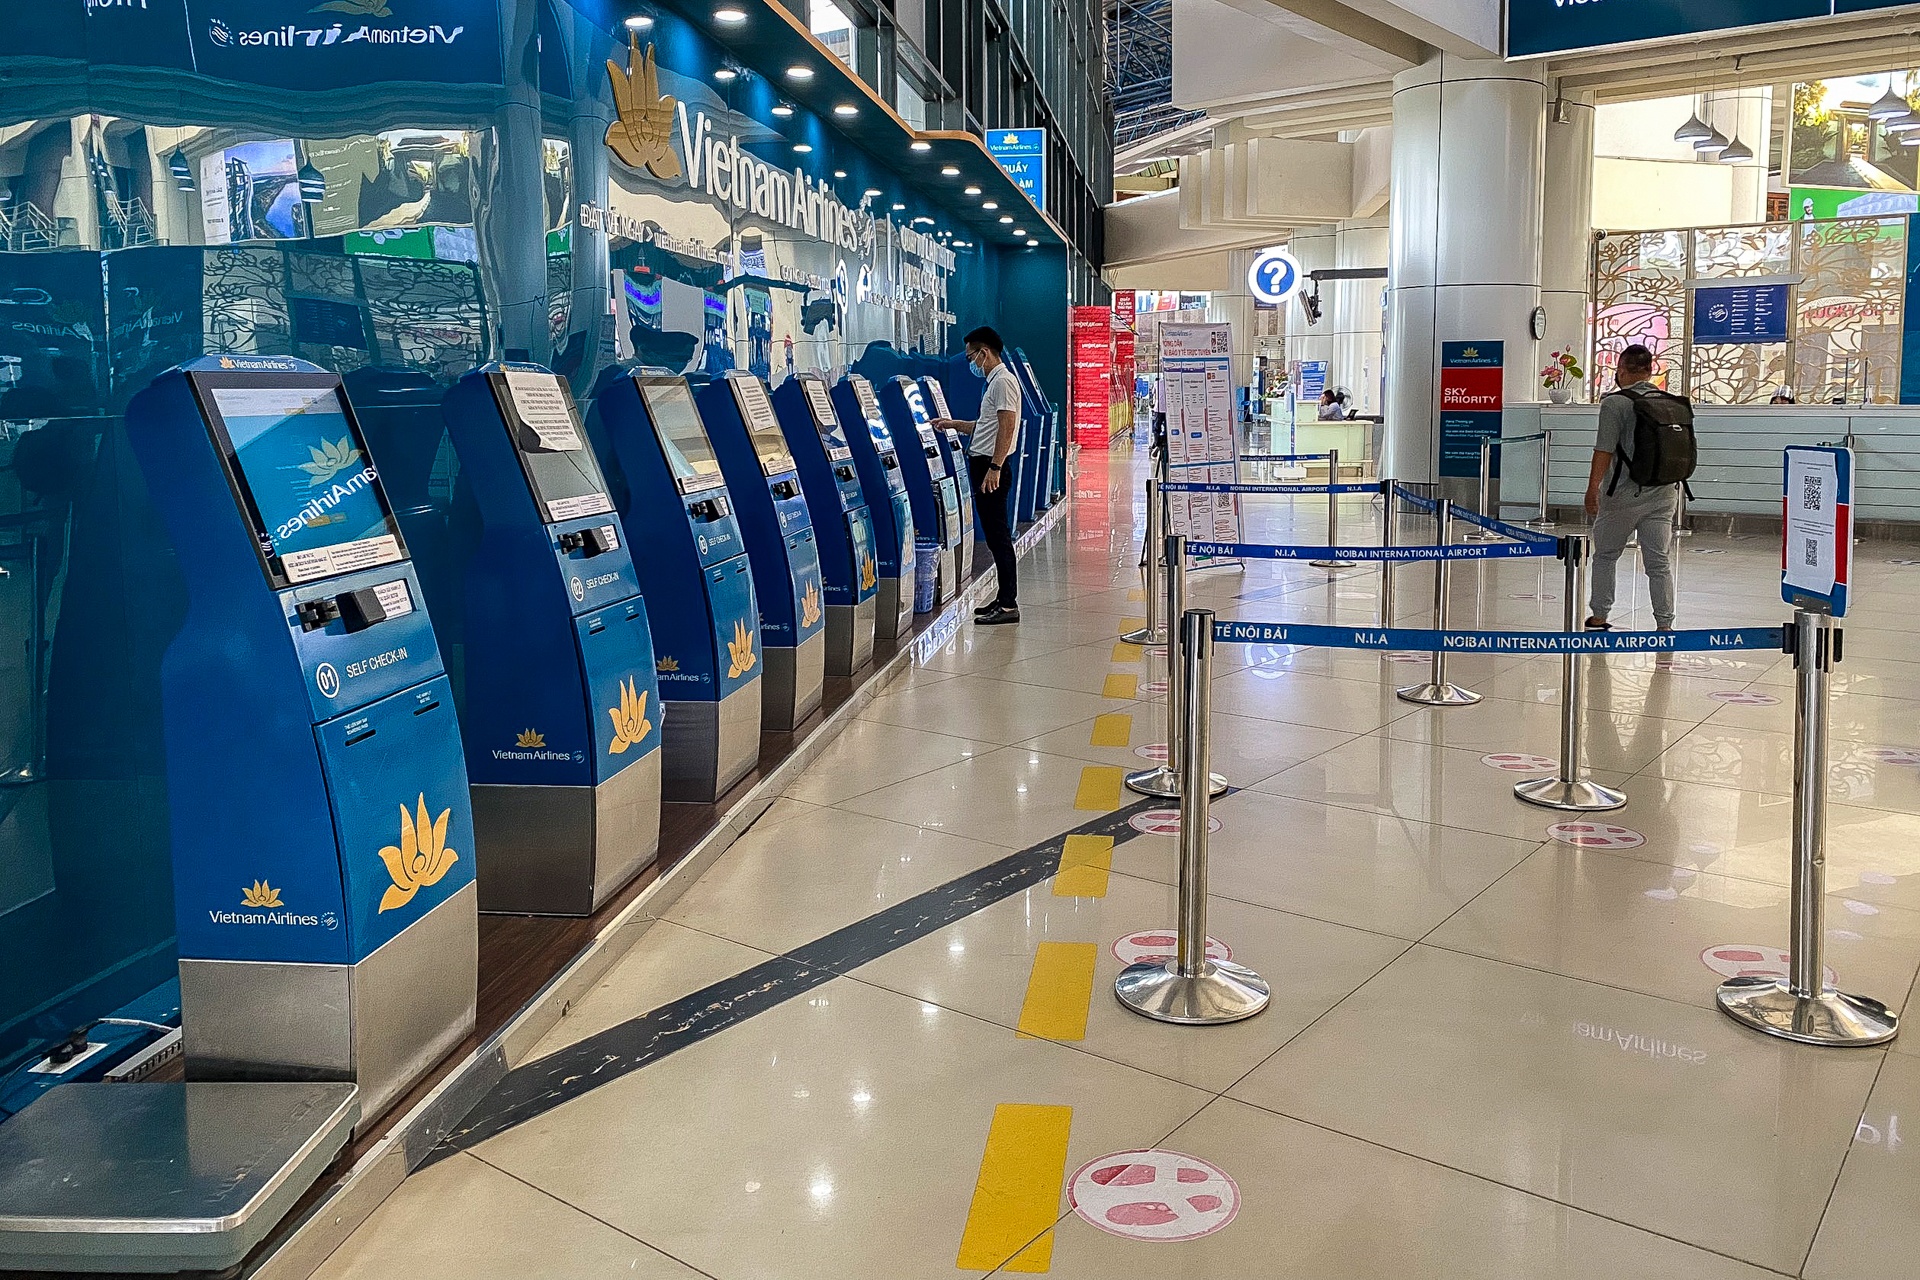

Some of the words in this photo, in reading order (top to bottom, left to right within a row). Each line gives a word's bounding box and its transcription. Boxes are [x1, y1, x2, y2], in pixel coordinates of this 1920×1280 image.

[1444, 387, 1467, 396] SKY
[1444, 396, 1496, 404] PRIORITY
[1199, 544, 1216, 556] NỘI
[1275, 549, 1298, 557] N.I.A
[1335, 549, 1367, 558] NOIBAI
[1369, 549, 1444, 559] INTERNATIONAL
[1447, 548, 1488, 557] AIRPORT
[1508, 546, 1532, 555] N.I.A
[1215, 623, 1233, 638] TẾ
[1235, 624, 1261, 641] NỘI
[1263, 626, 1288, 640] BÀI
[1355, 632, 1388, 645] N.I.A
[1443, 635, 1492, 649] NOIBAI
[1496, 636, 1610, 649] INTERNATIONAL
[1614, 635, 1676, 648] AIRPORT
[1709, 634, 1744, 646] N.I.A
[320, 670, 336, 688] 01
[346, 659, 369, 678] SELF
[368, 647, 408, 670] CHECK-IN
